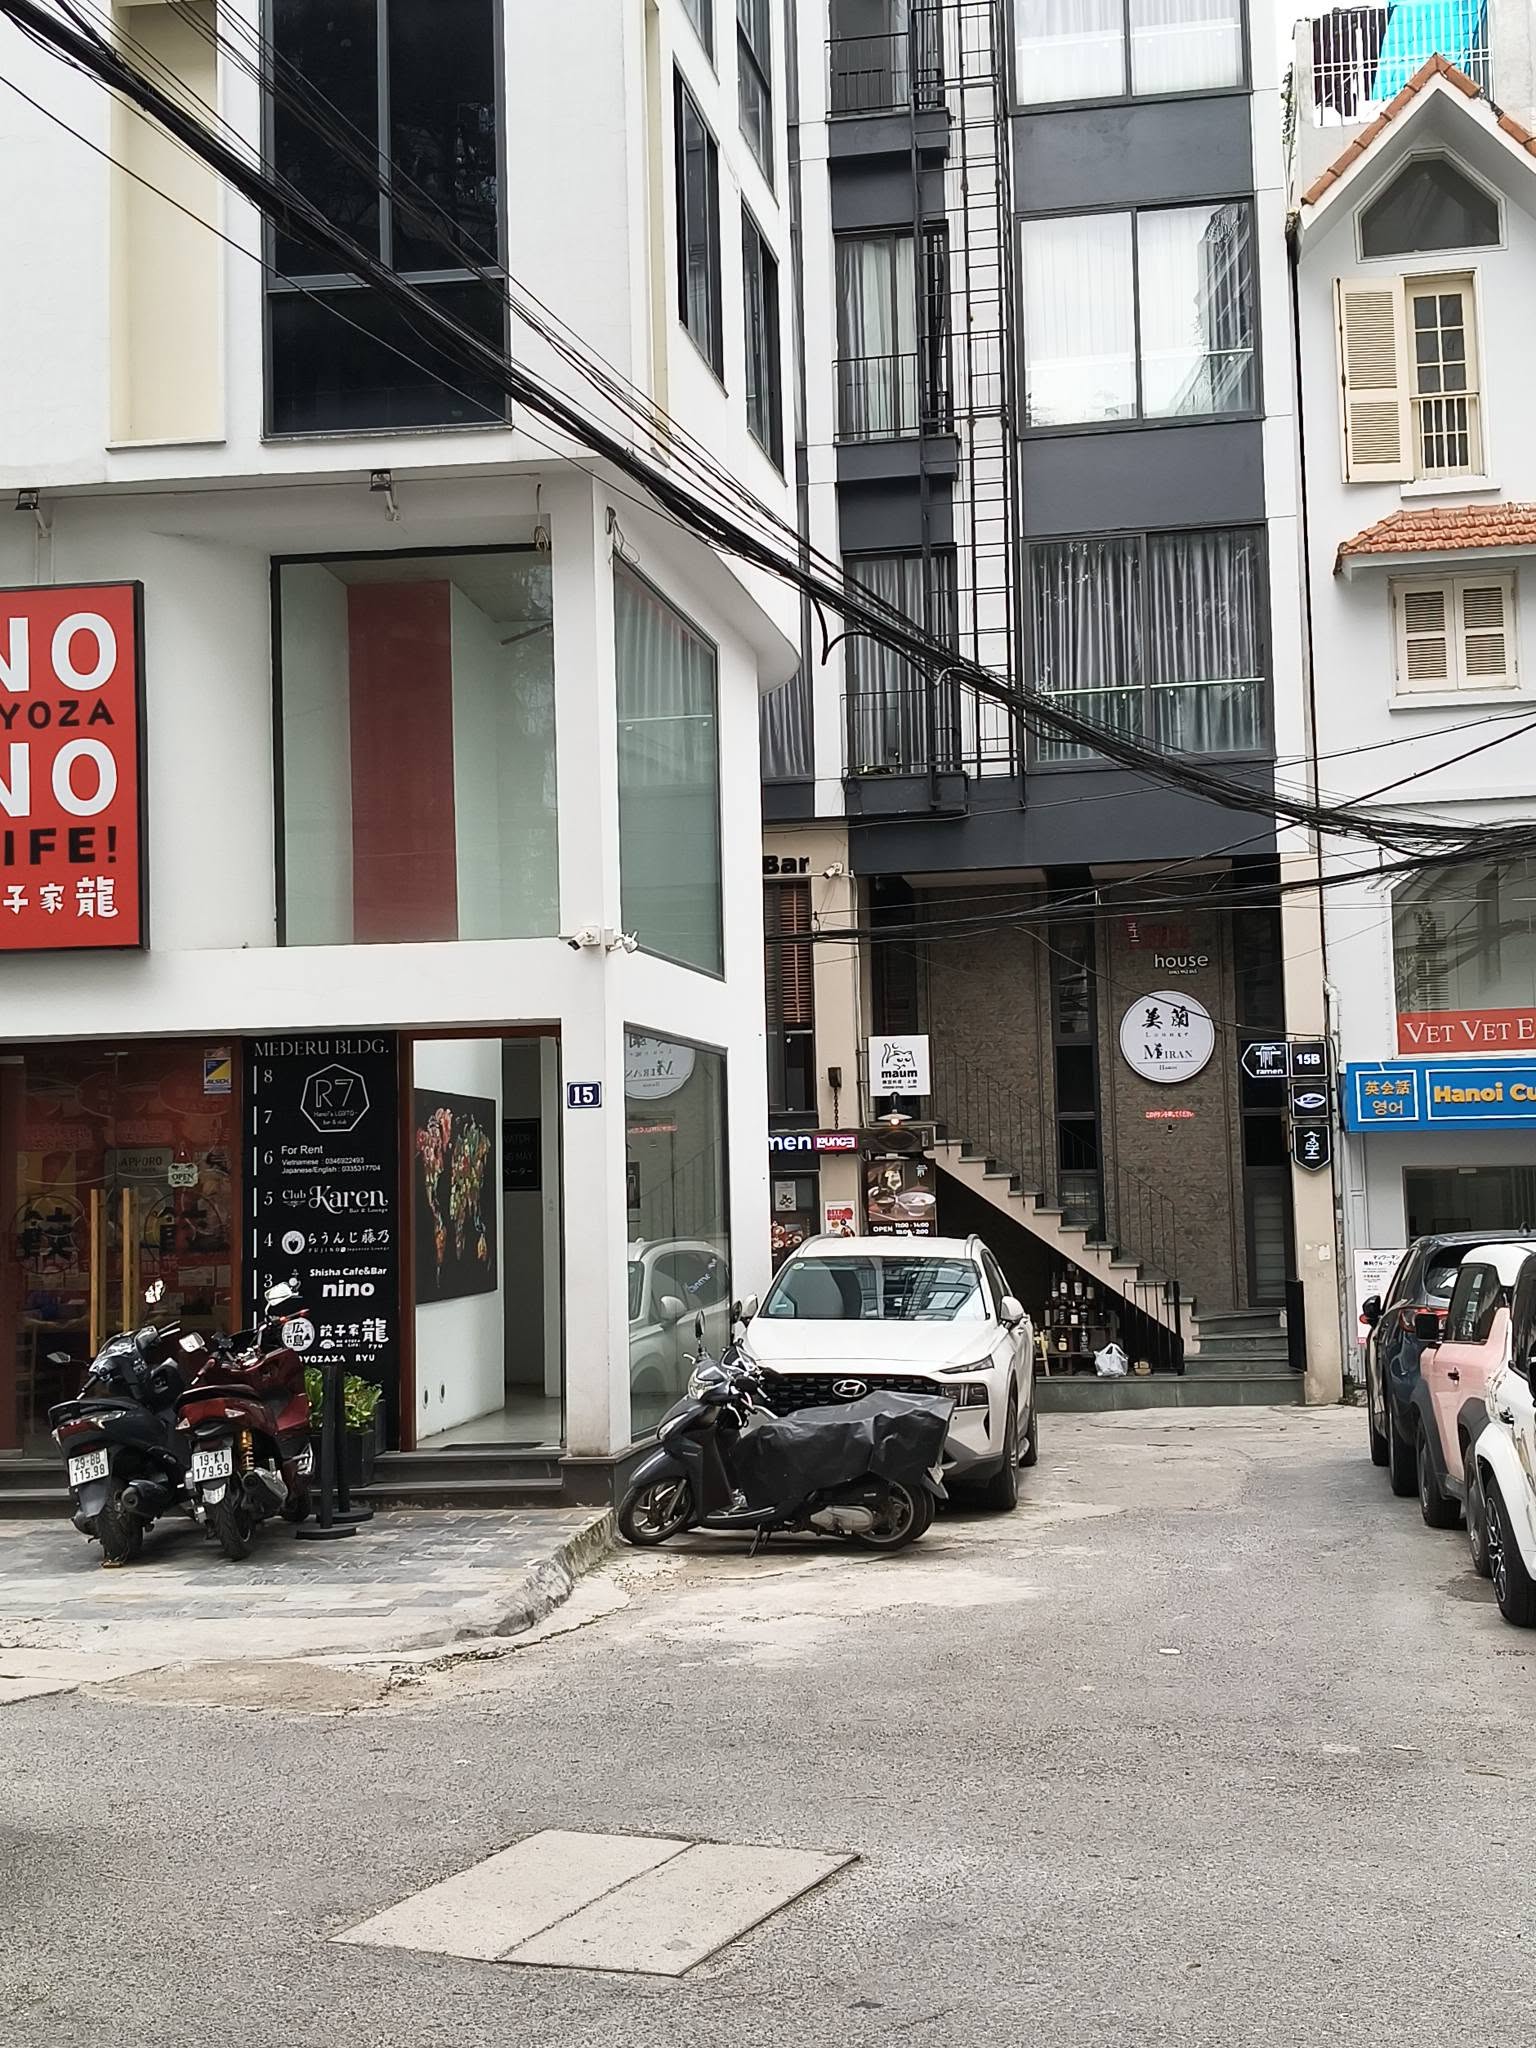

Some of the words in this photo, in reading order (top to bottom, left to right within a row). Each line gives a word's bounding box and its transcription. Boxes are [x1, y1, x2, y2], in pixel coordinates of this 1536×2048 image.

[763, 855, 810, 874] Bar
[1154, 953, 1209, 968] house
[1404, 1022, 1455, 1043] VET
[1460, 1019, 1511, 1041] VET
[254, 1040, 329, 1056] MEDERU
[335, 1039, 390, 1054] BLDG.
[1296, 1054, 1320, 1064] 15B
[264, 1069, 272, 1083] 8
[881, 1070, 918, 1078] maum
[315, 1079, 354, 1108] R7
[573, 1086, 594, 1104] 15
[1365, 1081, 1411, 1096] 英会話
[1433, 1083, 1503, 1103] Hanoi
[1372, 1100, 1403, 1116] 영어
[264, 1110, 273, 1124] 7
[264, 1150, 273, 1165] 6
[281, 1145, 298, 1155] For
[300, 1145, 323, 1154] Rent
[171, 1173, 194, 1181] OPEN
[264, 1192, 273, 1206] 5
[282, 1190, 306, 1200] Club
[308, 1186, 389, 1214] Karen
[264, 1233, 273, 1247] 4
[309, 1269, 341, 1277] Shisha
[342, 1267, 387, 1276] Cafe&Bar
[264, 1274, 273, 1288] 3
[322, 1280, 375, 1297] nino
[355, 1354, 376, 1362] RYU
[195, 1463, 231, 1480] 179.59
